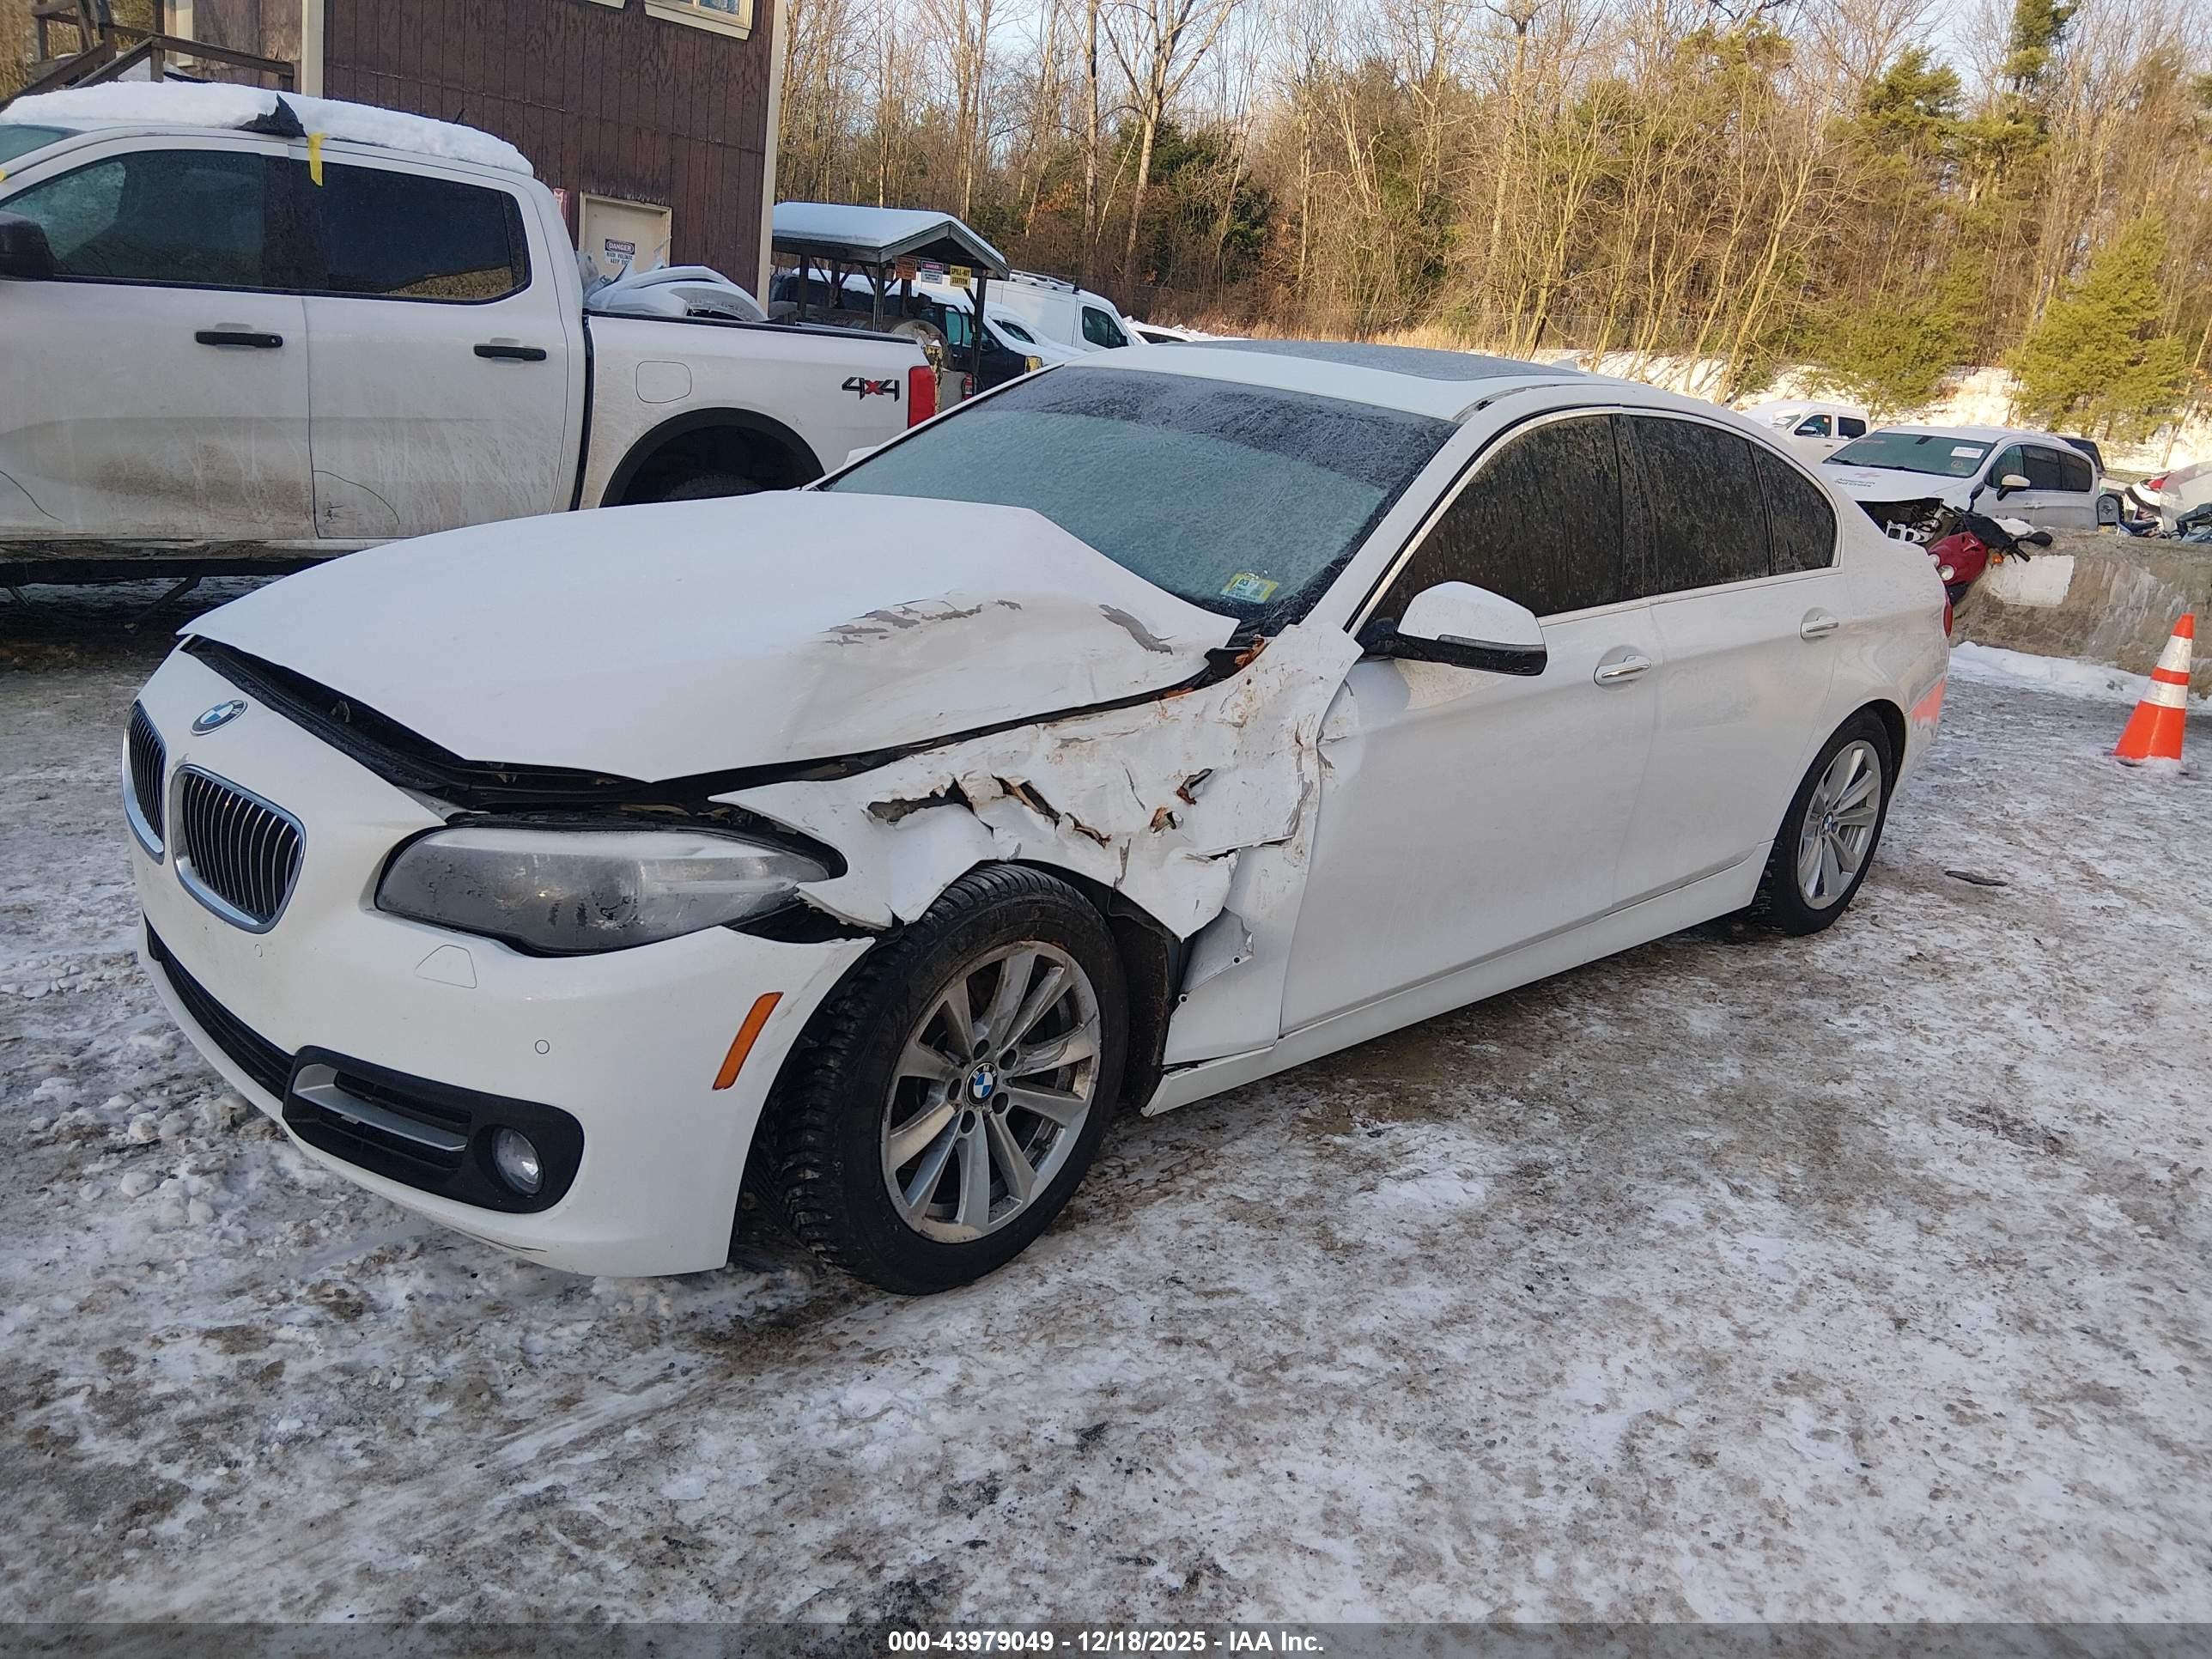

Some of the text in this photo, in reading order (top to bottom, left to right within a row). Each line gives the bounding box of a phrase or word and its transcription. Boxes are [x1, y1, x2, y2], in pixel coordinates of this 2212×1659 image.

[609, 242, 631, 252] DANGER
[951, 276, 968, 285] STATION
[972, 1064, 996, 1079] BMW
